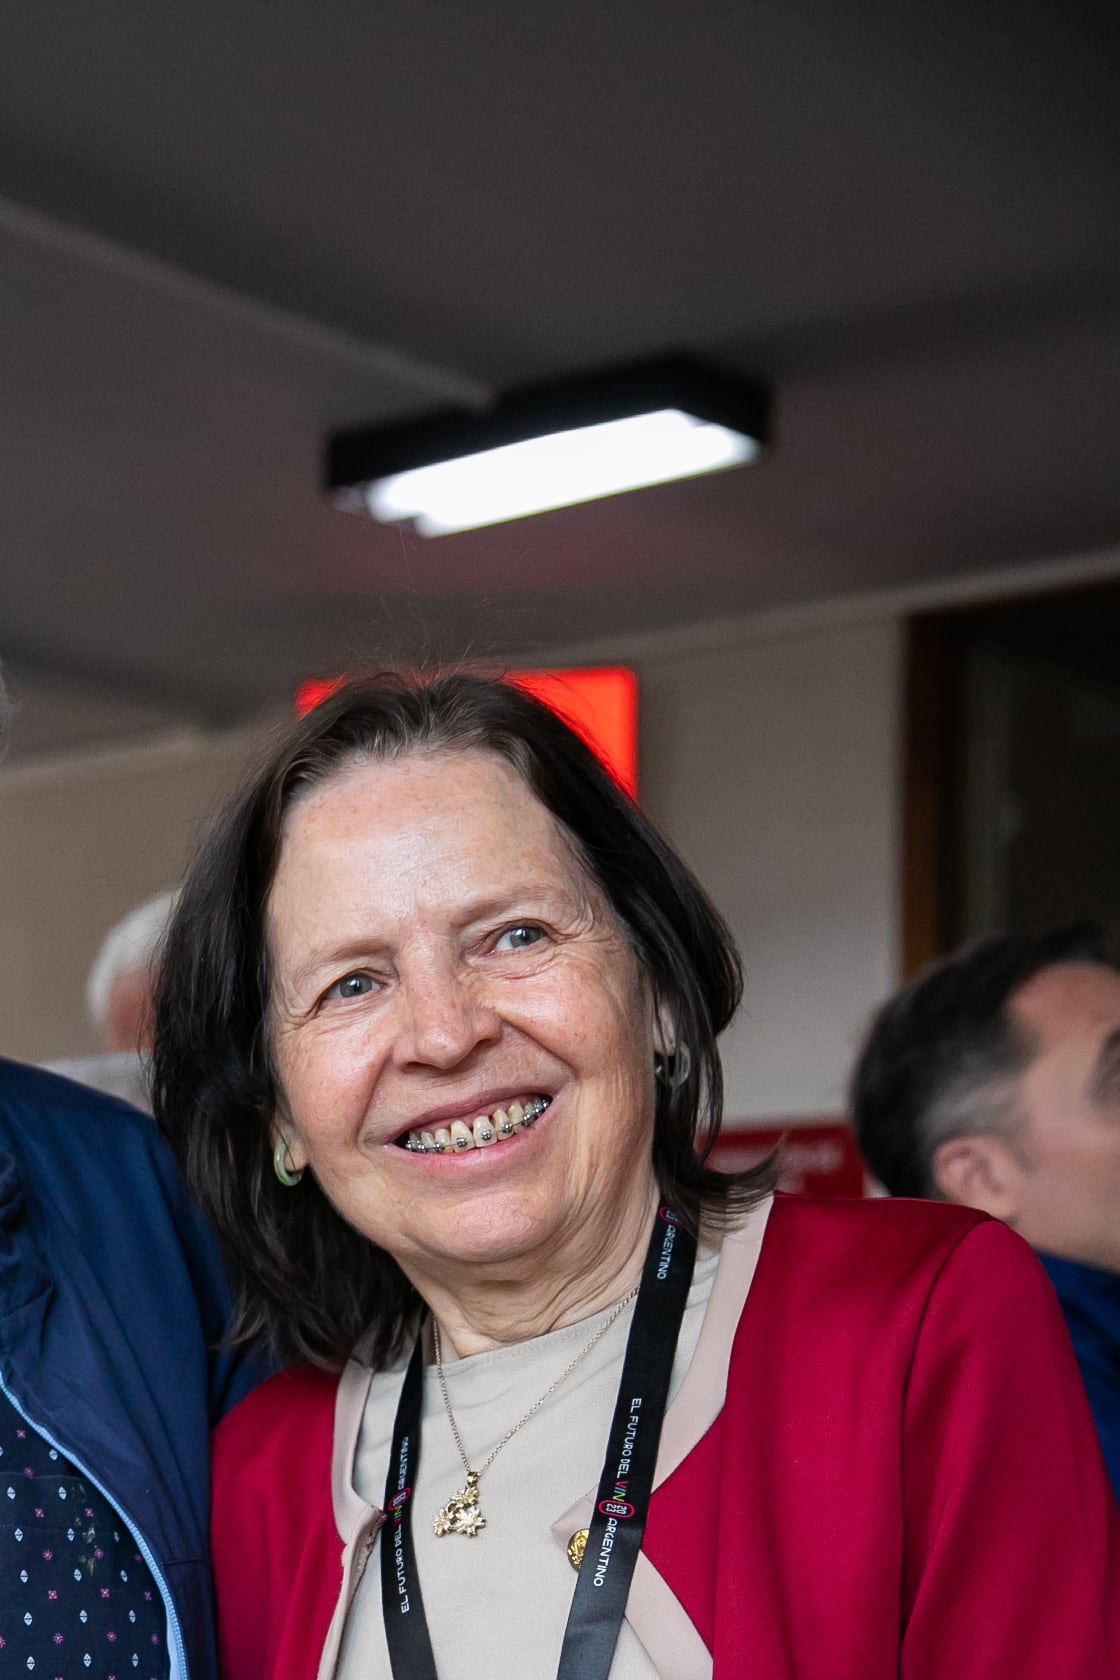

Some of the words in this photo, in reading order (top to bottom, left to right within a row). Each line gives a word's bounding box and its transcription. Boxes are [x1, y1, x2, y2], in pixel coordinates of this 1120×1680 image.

[657, 1225, 676, 1279] ARGENTINO
[631, 1398, 642, 1413] EL
[623, 1416, 639, 1456] FUTURO
[617, 1459, 630, 1479] DEL
[396, 1548, 407, 1594] FUTURO
[593, 1517, 617, 1587] ARGENTINO
[401, 1595, 410, 1613] EL
